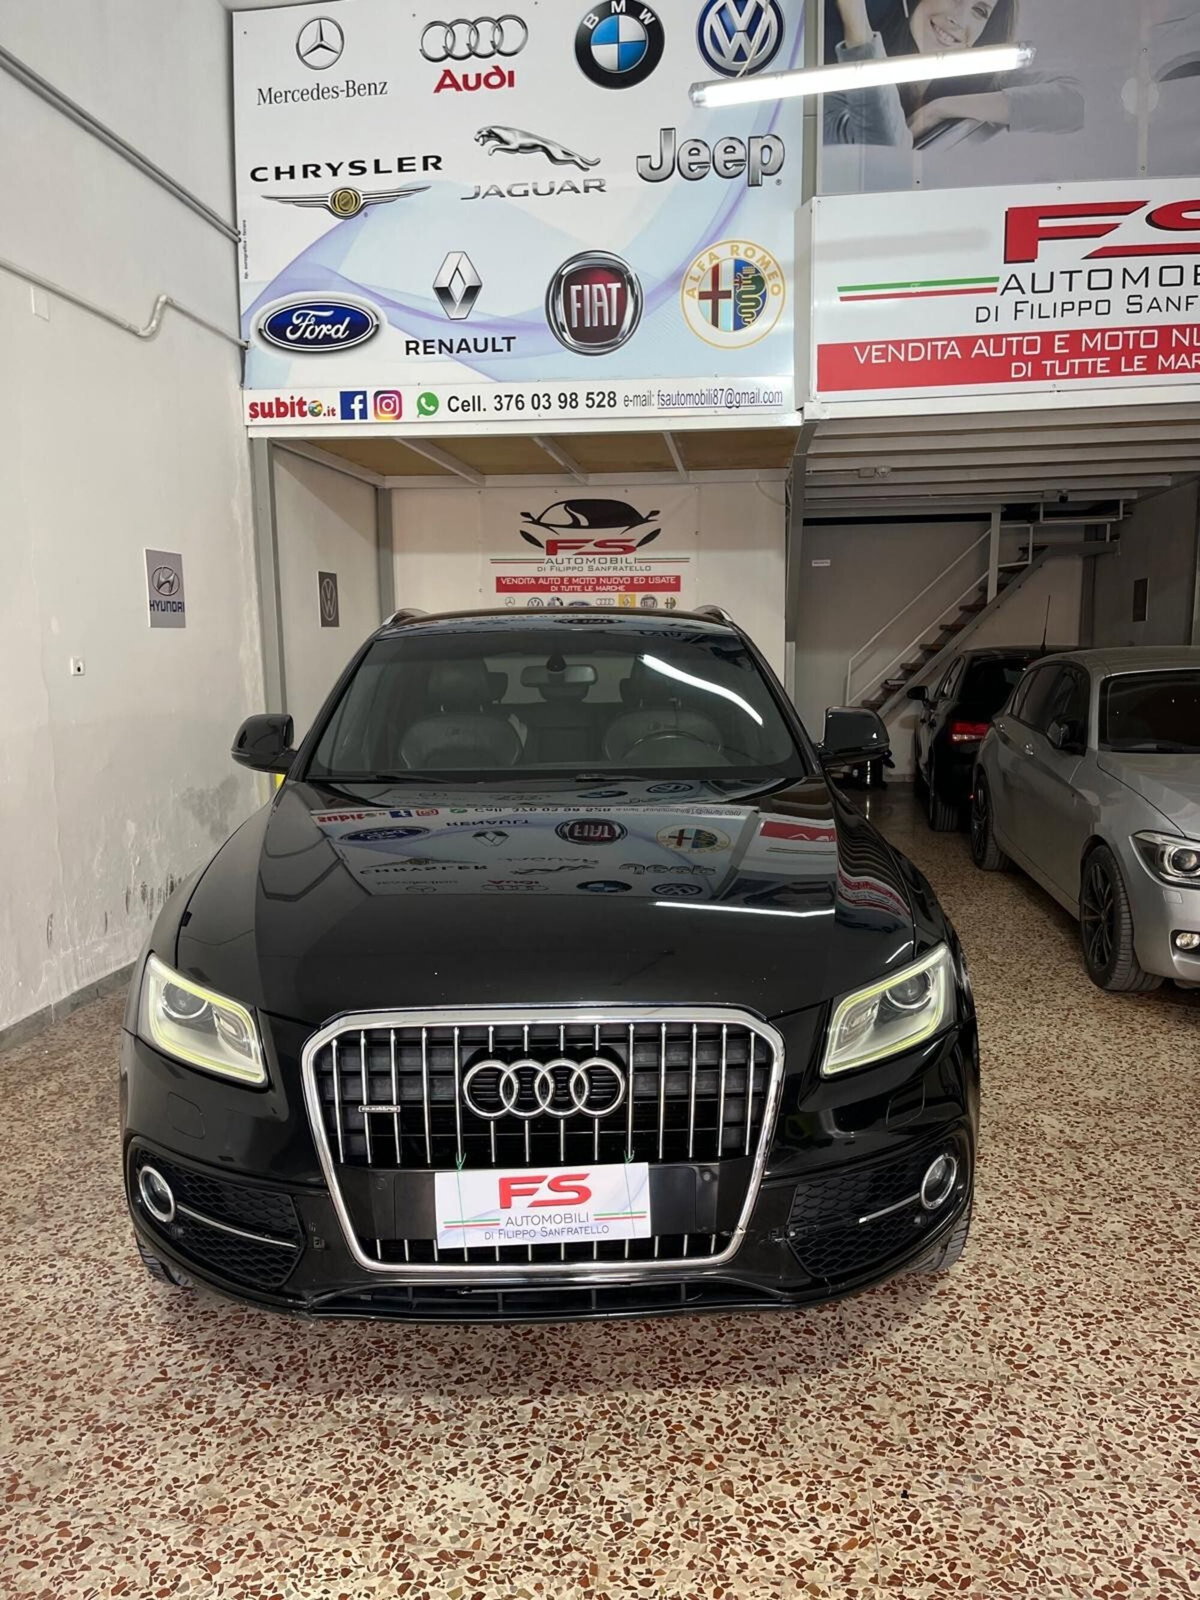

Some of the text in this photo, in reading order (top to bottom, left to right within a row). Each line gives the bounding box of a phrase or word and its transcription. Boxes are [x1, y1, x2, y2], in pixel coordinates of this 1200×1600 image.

[583, 0, 656, 29] BMW
[257, 79, 388, 105] Mercedes-Benz
[250, 155, 443, 182] CHRYSLER
[637, 127, 785, 187] Jeep
[460, 178, 607, 200] JAGUAR
[686, 243, 782, 299] ALFA ROMEO
[570, 282, 622, 329] FIAT
[975, 307, 999, 323] DI
[1014, 299, 1111, 321] FILIPPO
[286, 309, 351, 341] Ford
[405, 336, 517, 356] RENAULT
[853, 340, 962, 364] VENDITA
[971, 336, 1041, 358] AUTO
[1054, 333, 1070, 354] E
[1081, 329, 1159, 352] MOTO
[1010, 361, 1032, 378] DI
[1042, 356, 1111, 377] TUTTE
[1121, 354, 1148, 373] LE
[447, 388, 784, 413] Cell. 376 03 98 528 e-mail: fsautomobili87@gmail.com
[546, 538, 637, 556] FS
[545, 557, 637, 565] AUTOMOBILI
[587, 564, 652, 572] SANFRATELLO
[500, 576, 676, 585] VENDITA AUTO E MOTO NUOVO ED USATE
[150, 599, 185, 613] HYUNDAI
[498, 1173, 592, 1209] FS
[505, 1212, 590, 1228] AUTOMOBILI
[484, 1225, 610, 1240] DI FILIPPO SANFRATELLO
